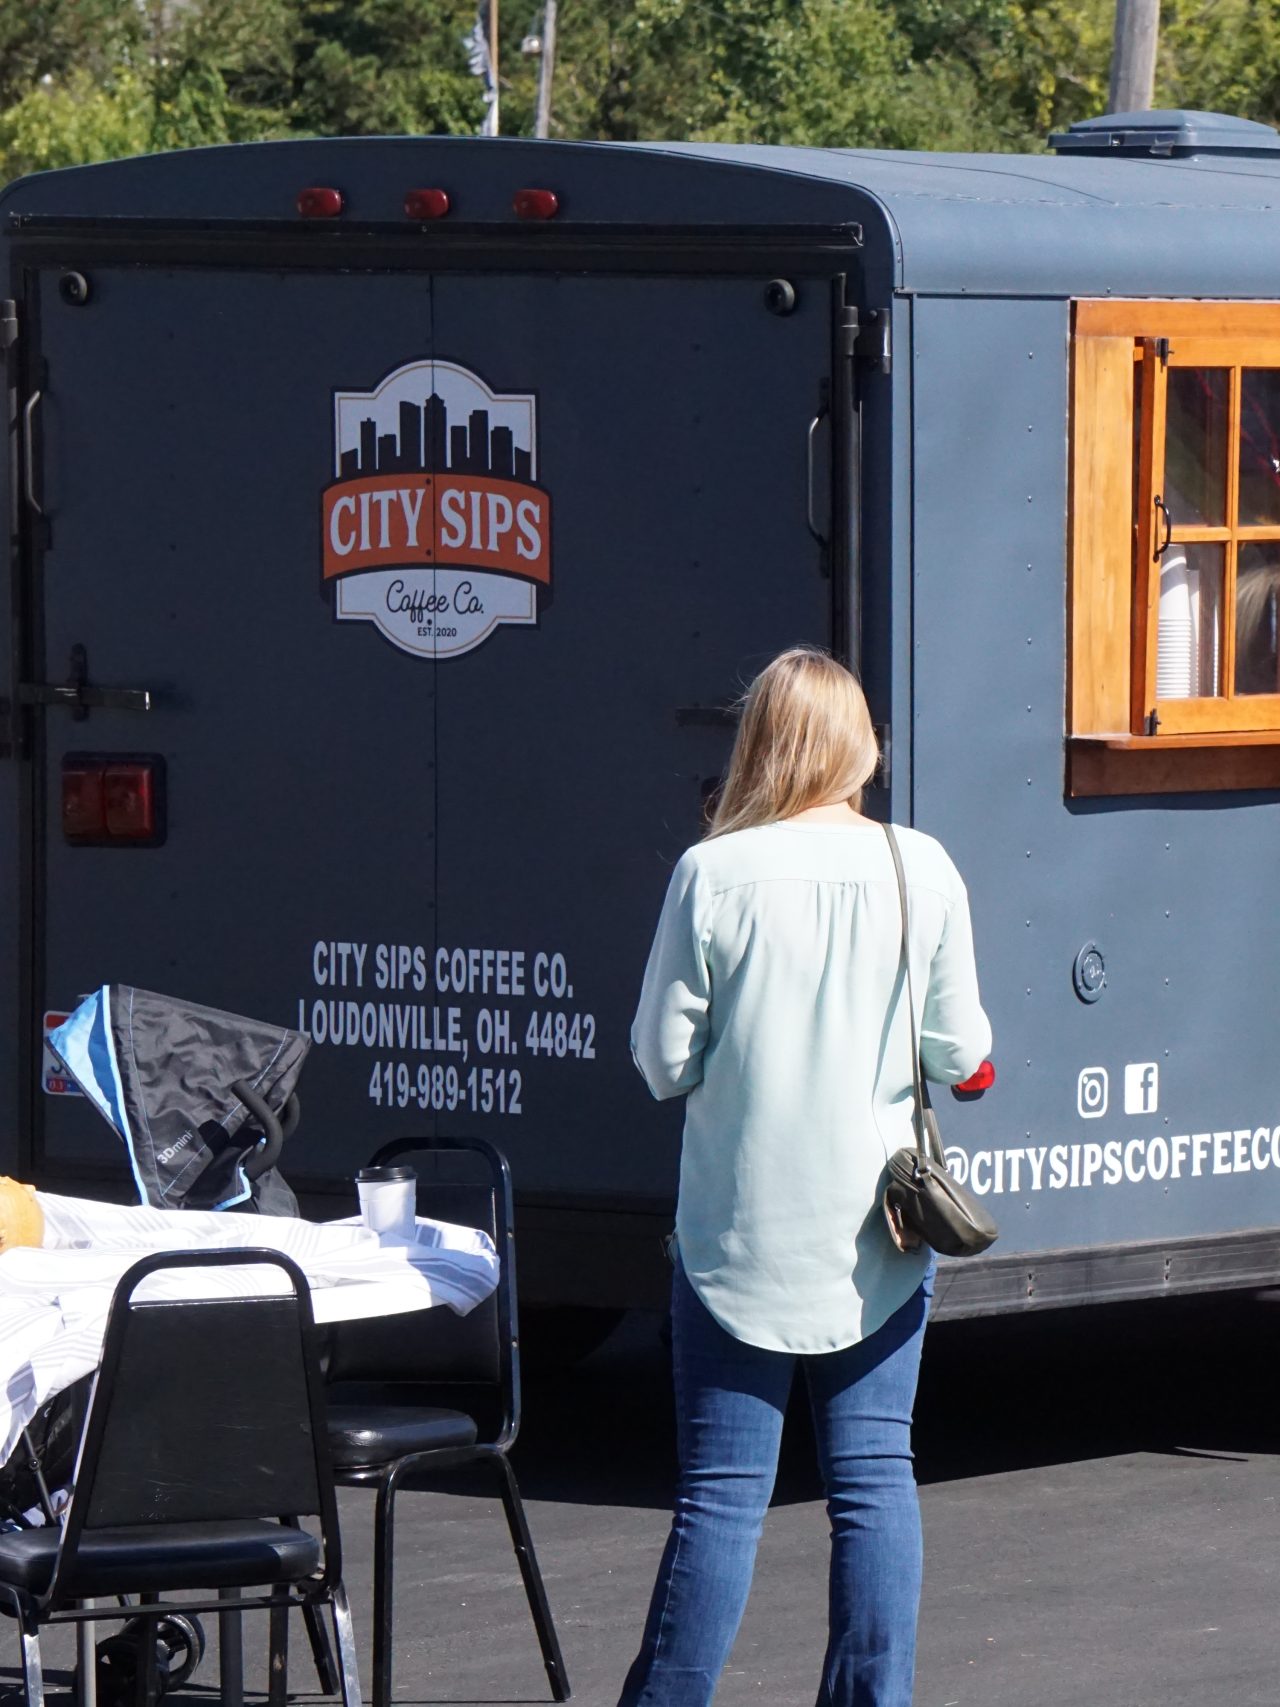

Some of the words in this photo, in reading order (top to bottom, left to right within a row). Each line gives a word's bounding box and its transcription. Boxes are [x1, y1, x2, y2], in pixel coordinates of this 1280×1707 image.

[330, 489, 425, 556] CITY
[440, 488, 541, 561] SIPS
[386, 579, 450, 624] Coffee
[453, 581, 484, 615] Co.
[417, 627, 433, 637] EST.
[436, 627, 457, 637] 2020
[313, 940, 368, 987] CITY
[375, 943, 427, 991] SIPS
[435, 947, 525, 996] COFFEE
[533, 952, 573, 998] CO.
[299, 999, 468, 1063] LOUDONVILLE,
[476, 1008, 517, 1054] OH.
[525, 1010, 596, 1059] 44842
[368, 1061, 522, 1114] 419-989-1512
